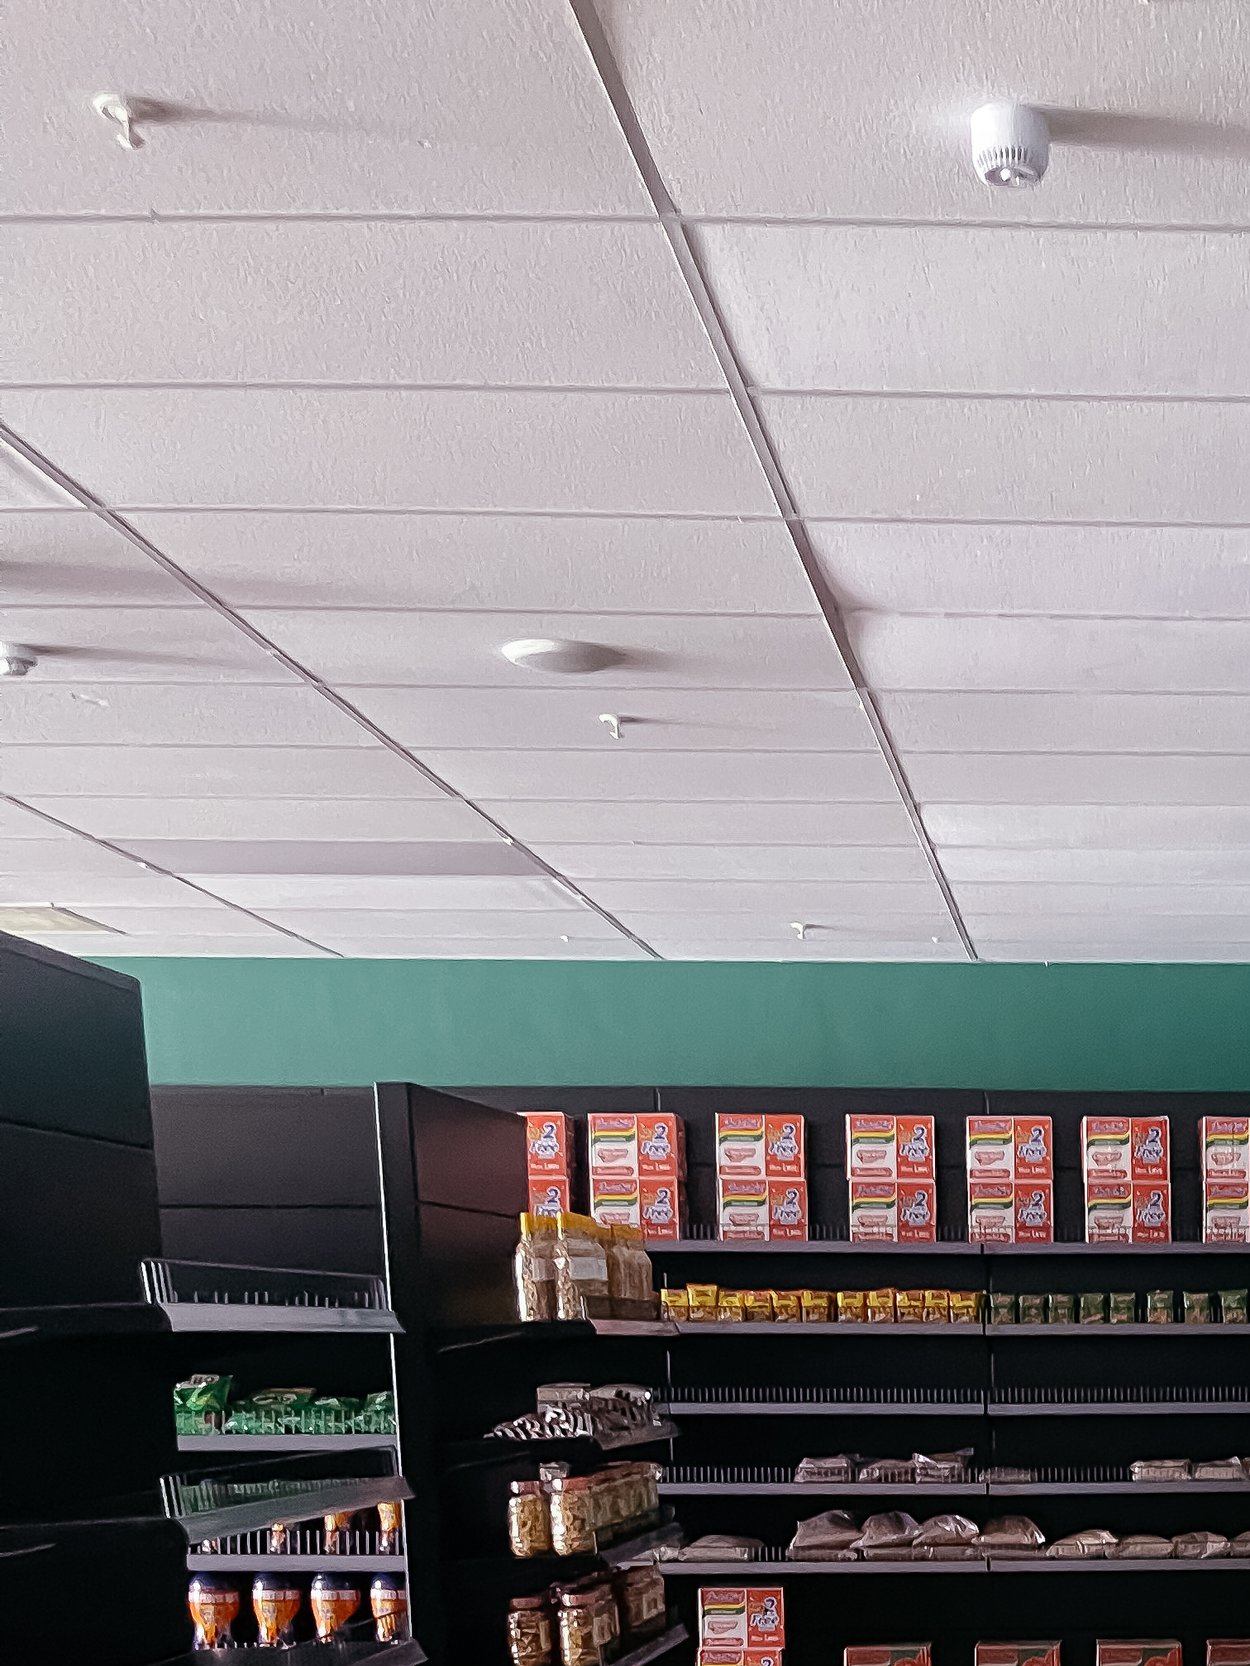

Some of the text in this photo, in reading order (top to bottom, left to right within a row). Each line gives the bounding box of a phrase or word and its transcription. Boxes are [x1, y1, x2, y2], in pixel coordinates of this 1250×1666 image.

[542, 1124, 555, 1139] 2
[654, 1125, 666, 1140] 2
[782, 1124, 794, 1140] 2
[913, 1126, 925, 1140] 2
[1031, 1127, 1042, 1142] 2
[1147, 1128, 1159, 1143] 2
[547, 1188, 559, 1203] 2
[656, 1189, 668, 1204] 2
[786, 1190, 797, 1204] 2
[914, 1191, 926, 1206] 2
[1031, 1192, 1043, 1206] 2
[1149, 1192, 1161, 1207] 2
[752, 1614, 779, 1625] Free
